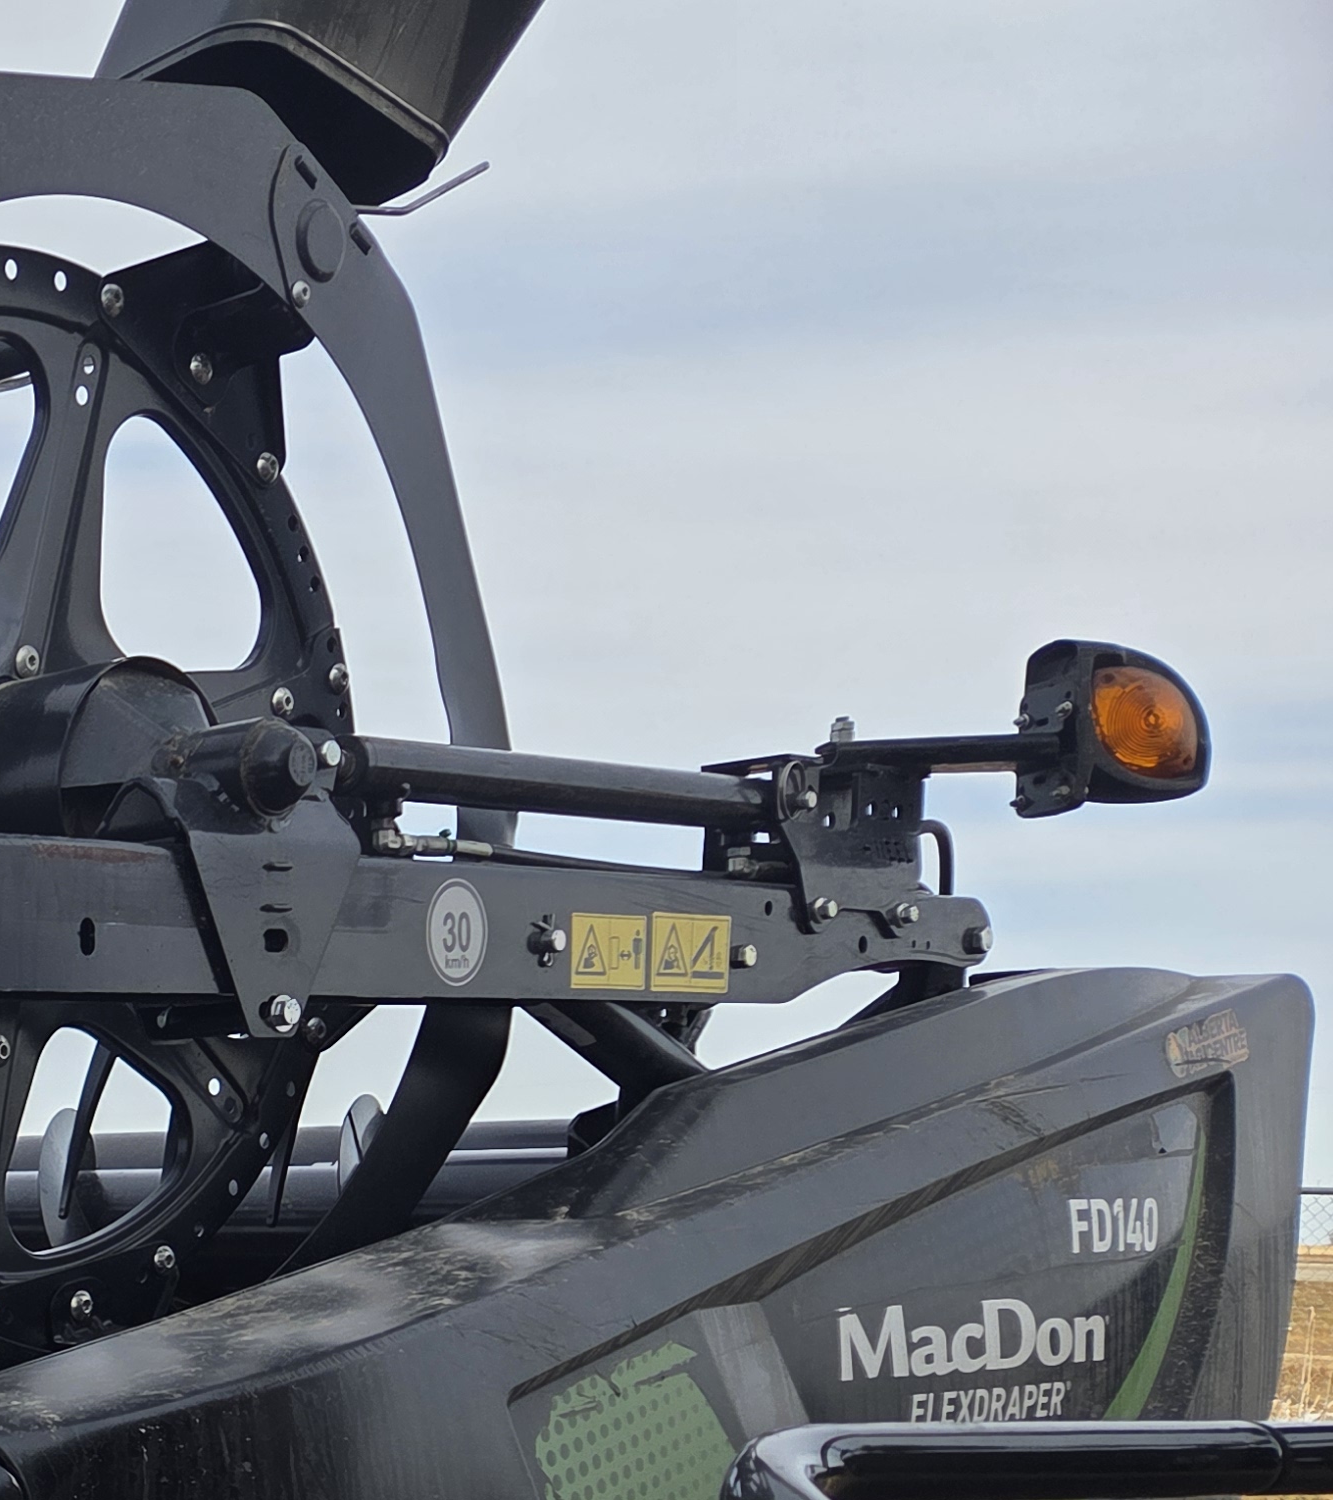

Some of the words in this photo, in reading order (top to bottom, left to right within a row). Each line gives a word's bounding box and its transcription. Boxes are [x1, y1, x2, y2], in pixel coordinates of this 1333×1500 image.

[442, 911, 471, 953] 30
[444, 954, 470, 969] km/h
[1068, 1197, 1159, 1254] FD140
[835, 1298, 1106, 1382] MacDon
[910, 1381, 1066, 1424] FLEXDRAPER
